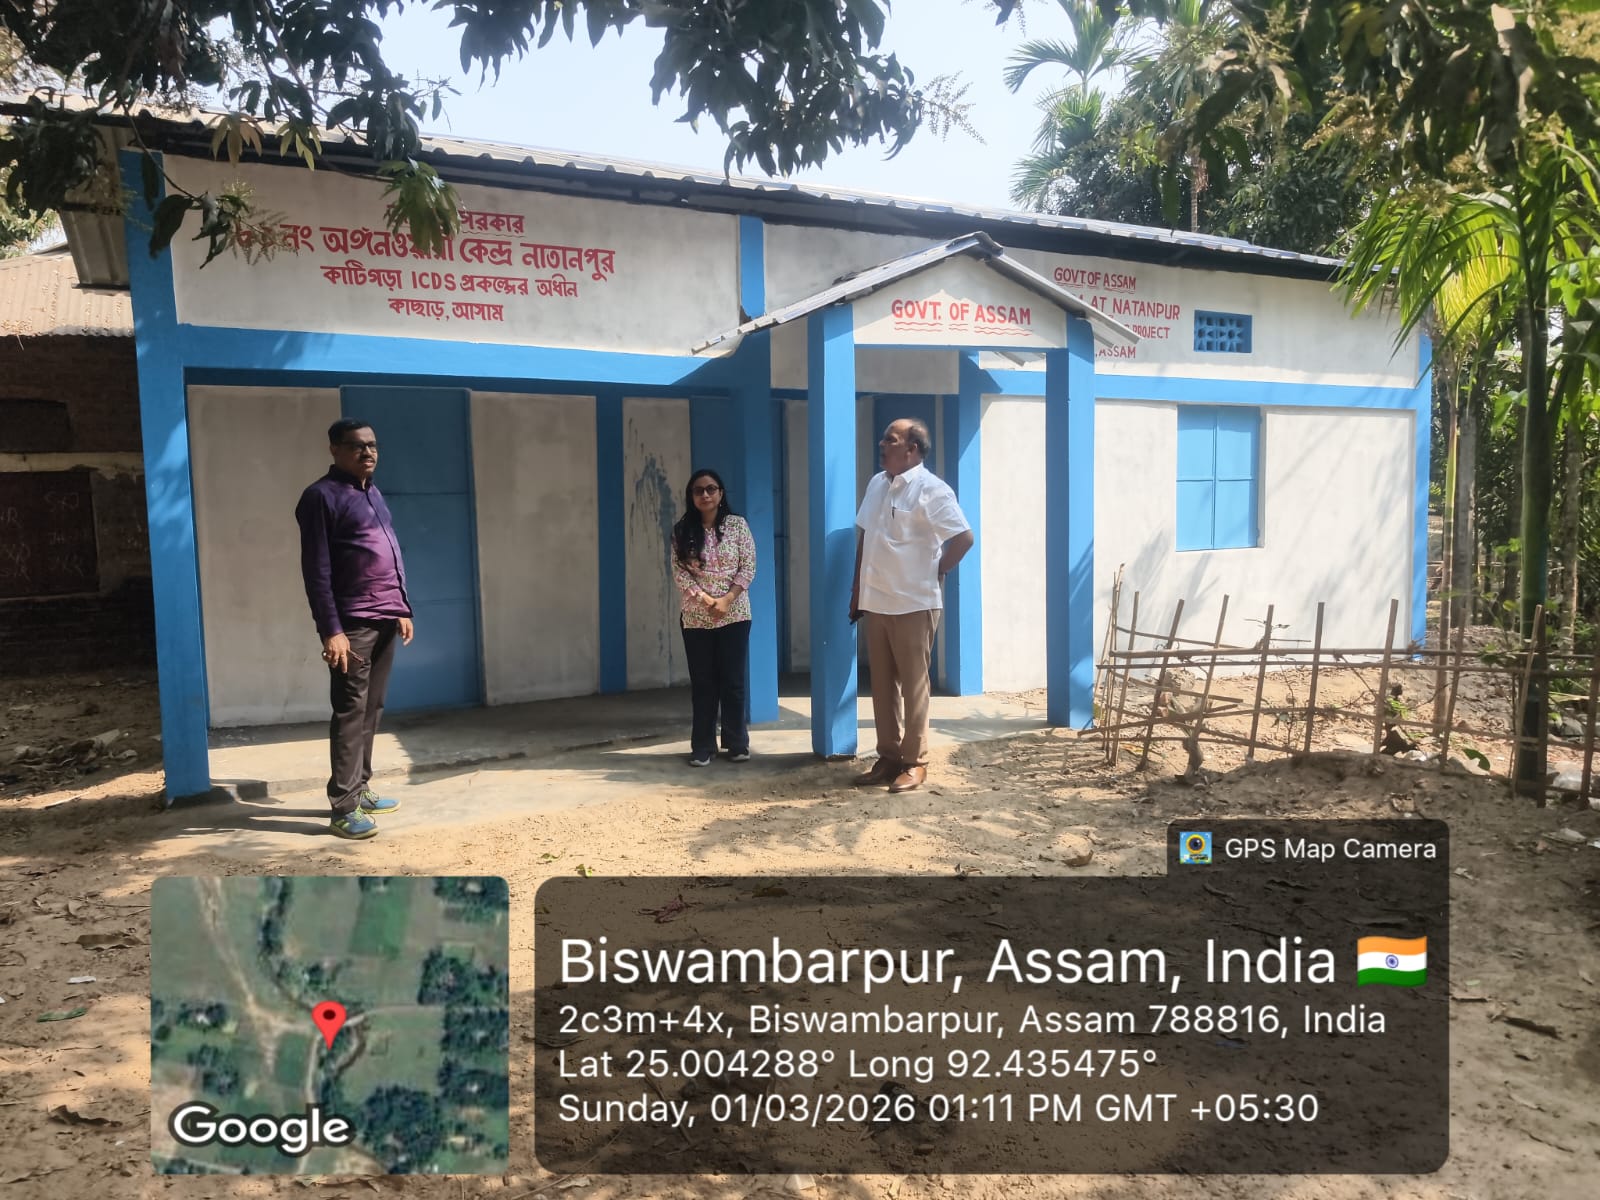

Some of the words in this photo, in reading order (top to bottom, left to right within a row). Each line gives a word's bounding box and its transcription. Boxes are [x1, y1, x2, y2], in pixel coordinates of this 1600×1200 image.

[280, 224, 314, 252] নং
[459, 238, 513, 266] কেন্দ্র
[520, 242, 616, 282] নাতানপুর
[320, 260, 403, 292] কাটিগড়া
[412, 271, 457, 291] ICDS
[535, 273, 578, 298] অধীন
[1087, 272, 1101, 285] OF
[1103, 272, 1137, 290] ASSAM
[892, 299, 941, 320] GOVT.
[949, 303, 969, 321] OF
[974, 304, 1031, 325] ASSAM
[1112, 298, 1180, 320] NATANPUR
